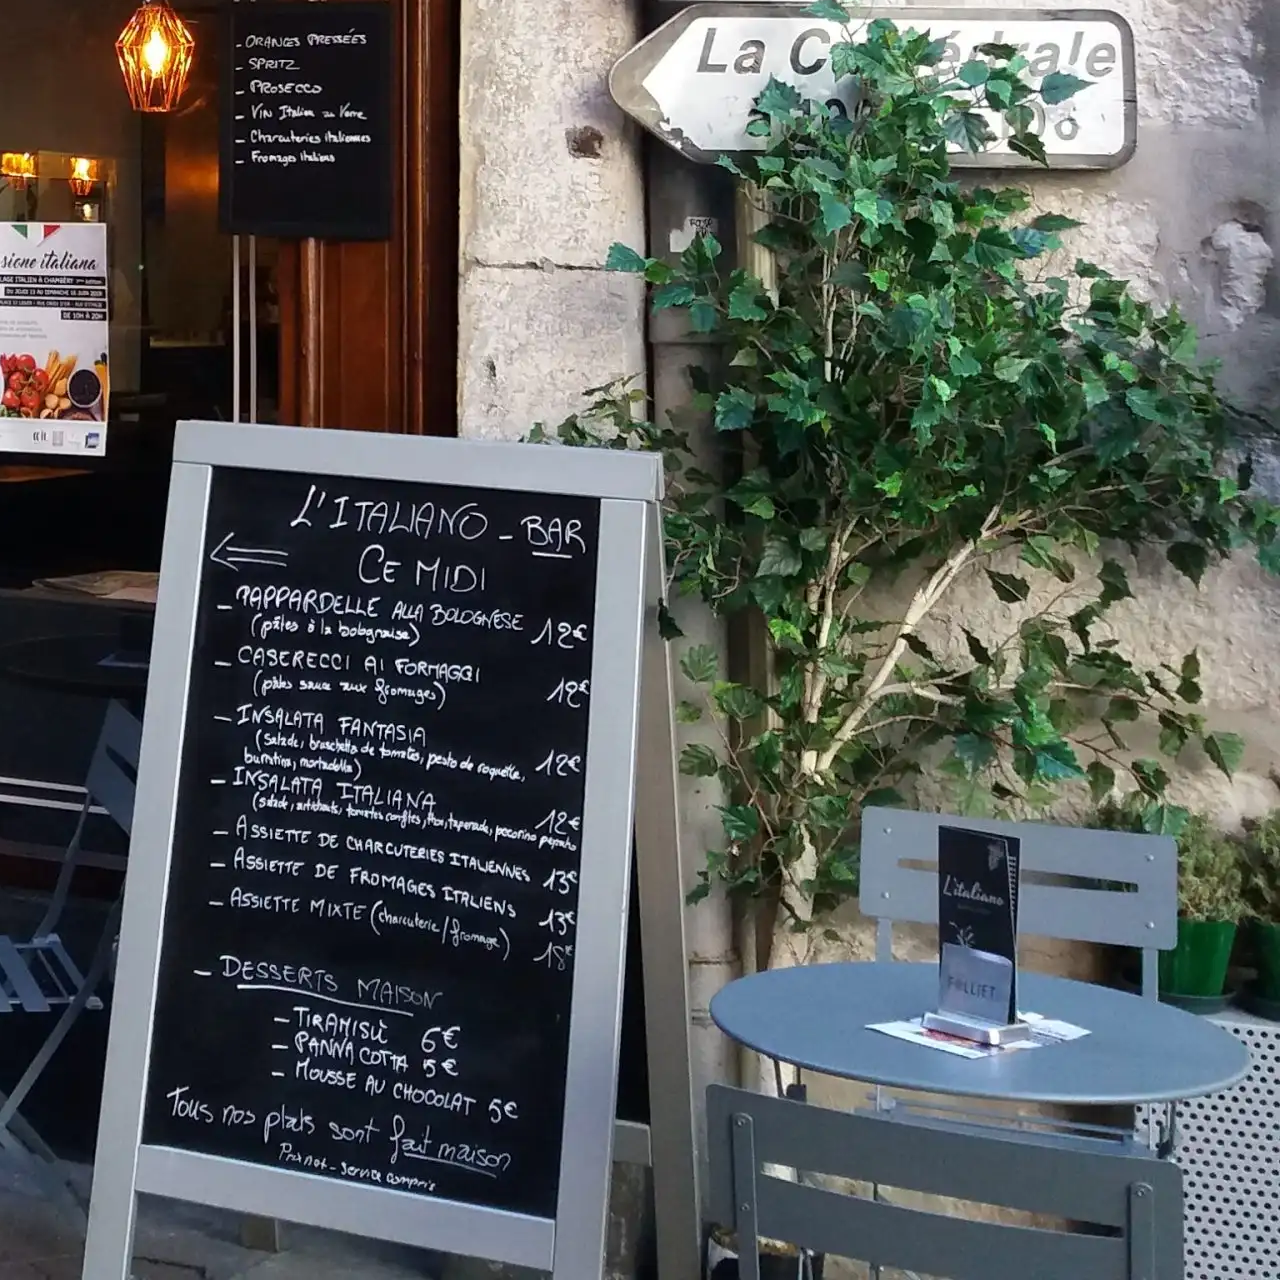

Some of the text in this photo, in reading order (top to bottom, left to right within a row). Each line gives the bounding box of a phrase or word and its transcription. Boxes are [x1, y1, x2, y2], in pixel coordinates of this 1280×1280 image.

[245, 28, 367, 49] ORANGES PRESSÉES
[697, 27, 766, 74] La
[248, 57, 300, 70] SPRITZ
[250, 80, 323, 95] PROSECCO
[250, 129, 321, 144] Charcuteries
[251, 150, 297, 167] Fromages
[39, 249, 99, 272] italiana
[14, 275, 38, 284] ITALIEN
[291, 484, 586, 554] L'ITALIANO BAR
[415, 556, 487, 592] MIDI
[235, 585, 588, 648] PAPPARDELLE ALLA BOLOGNESE 12€
[237, 645, 590, 708] CASERECCI AI FORMAGGI 12€
[236, 703, 427, 748] INSALATA FANTASIA
[360, 740, 376, 756] de
[426, 751, 458, 771] pesto
[459, 754, 474, 772] de
[535, 749, 581, 776] 12€
[232, 765, 437, 815] INSALATA ITALIANA
[494, 825, 537, 842] pecorino
[535, 808, 581, 835] 12€
[235, 814, 311, 845] ASSIETTE
[318, 832, 341, 849] DE
[346, 835, 445, 865] CHARCUTERIES
[449, 852, 532, 883] ITALIENNES
[233, 846, 306, 877] ASSIETTE
[315, 863, 338, 881] DE
[350, 866, 437, 899] FROMAGES
[441, 885, 517, 919] ITALIENS
[942, 873, 1006, 907] L'italiano
[230, 886, 301, 914] ASSIETTE
[310, 897, 368, 921] MIXTE
[220, 955, 444, 1011] DESSERTS MAISON
[294, 1030, 460, 1079] PANNA COTTA 5€
[421, 1025, 461, 1054] 6€
[295, 1058, 520, 1124] MOUSSE AU CHOCOLAT 5€
[166, 1085, 512, 1172] Tous nos plats sont fait maison
